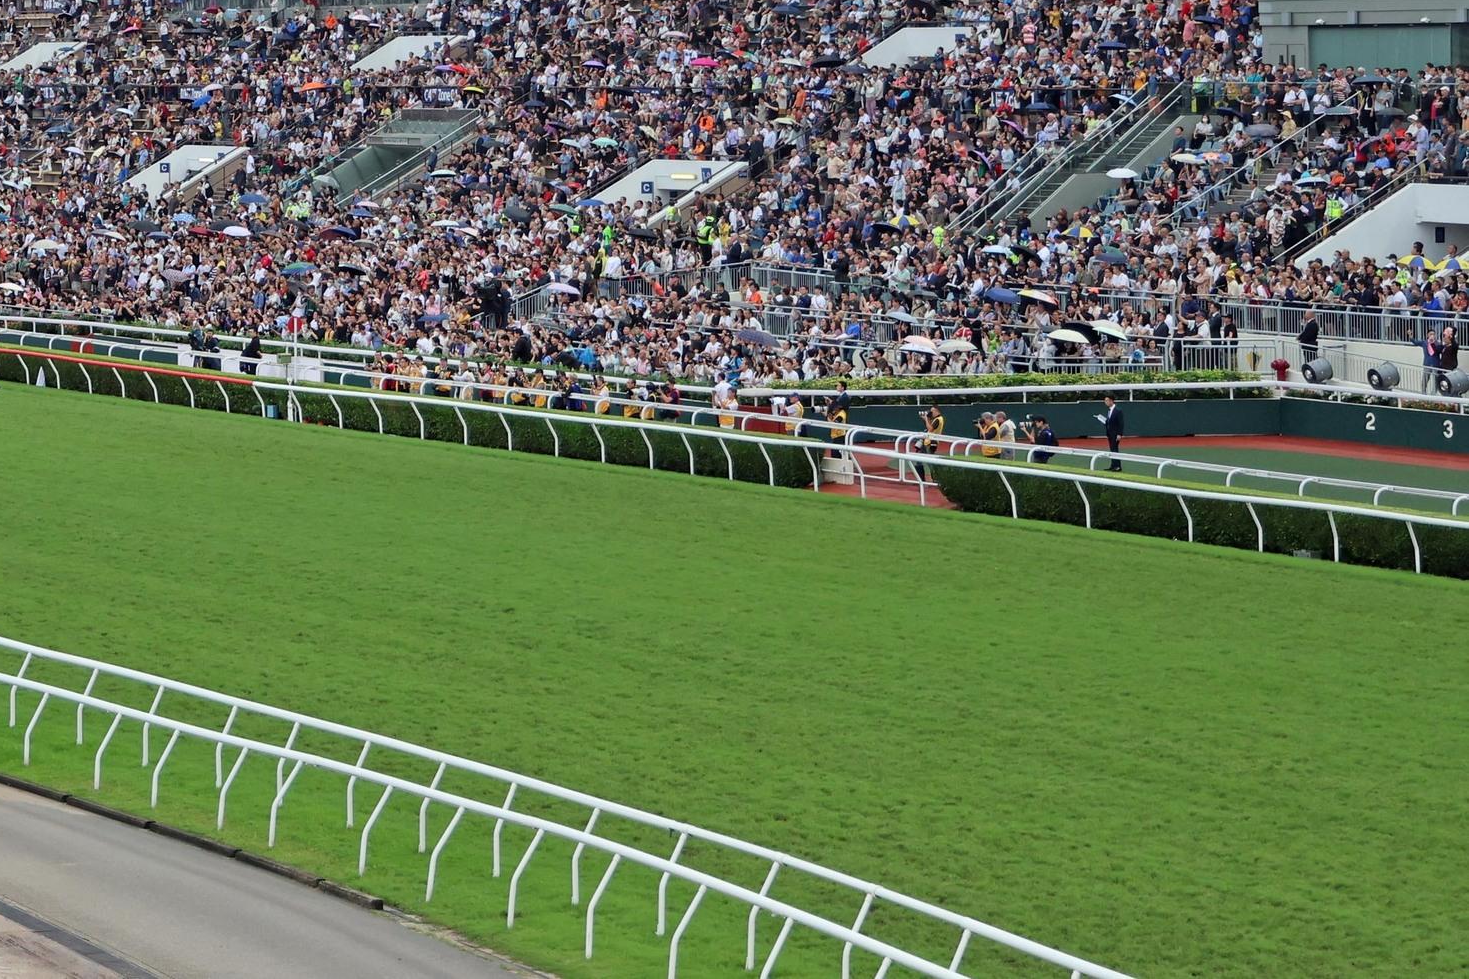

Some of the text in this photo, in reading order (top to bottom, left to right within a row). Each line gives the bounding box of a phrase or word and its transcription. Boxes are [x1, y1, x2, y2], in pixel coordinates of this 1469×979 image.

[438, 89, 451, 101] Zone
[643, 183, 650, 191] C
[1365, 412, 1376, 431] 2
[1443, 419, 1454, 439] 3
